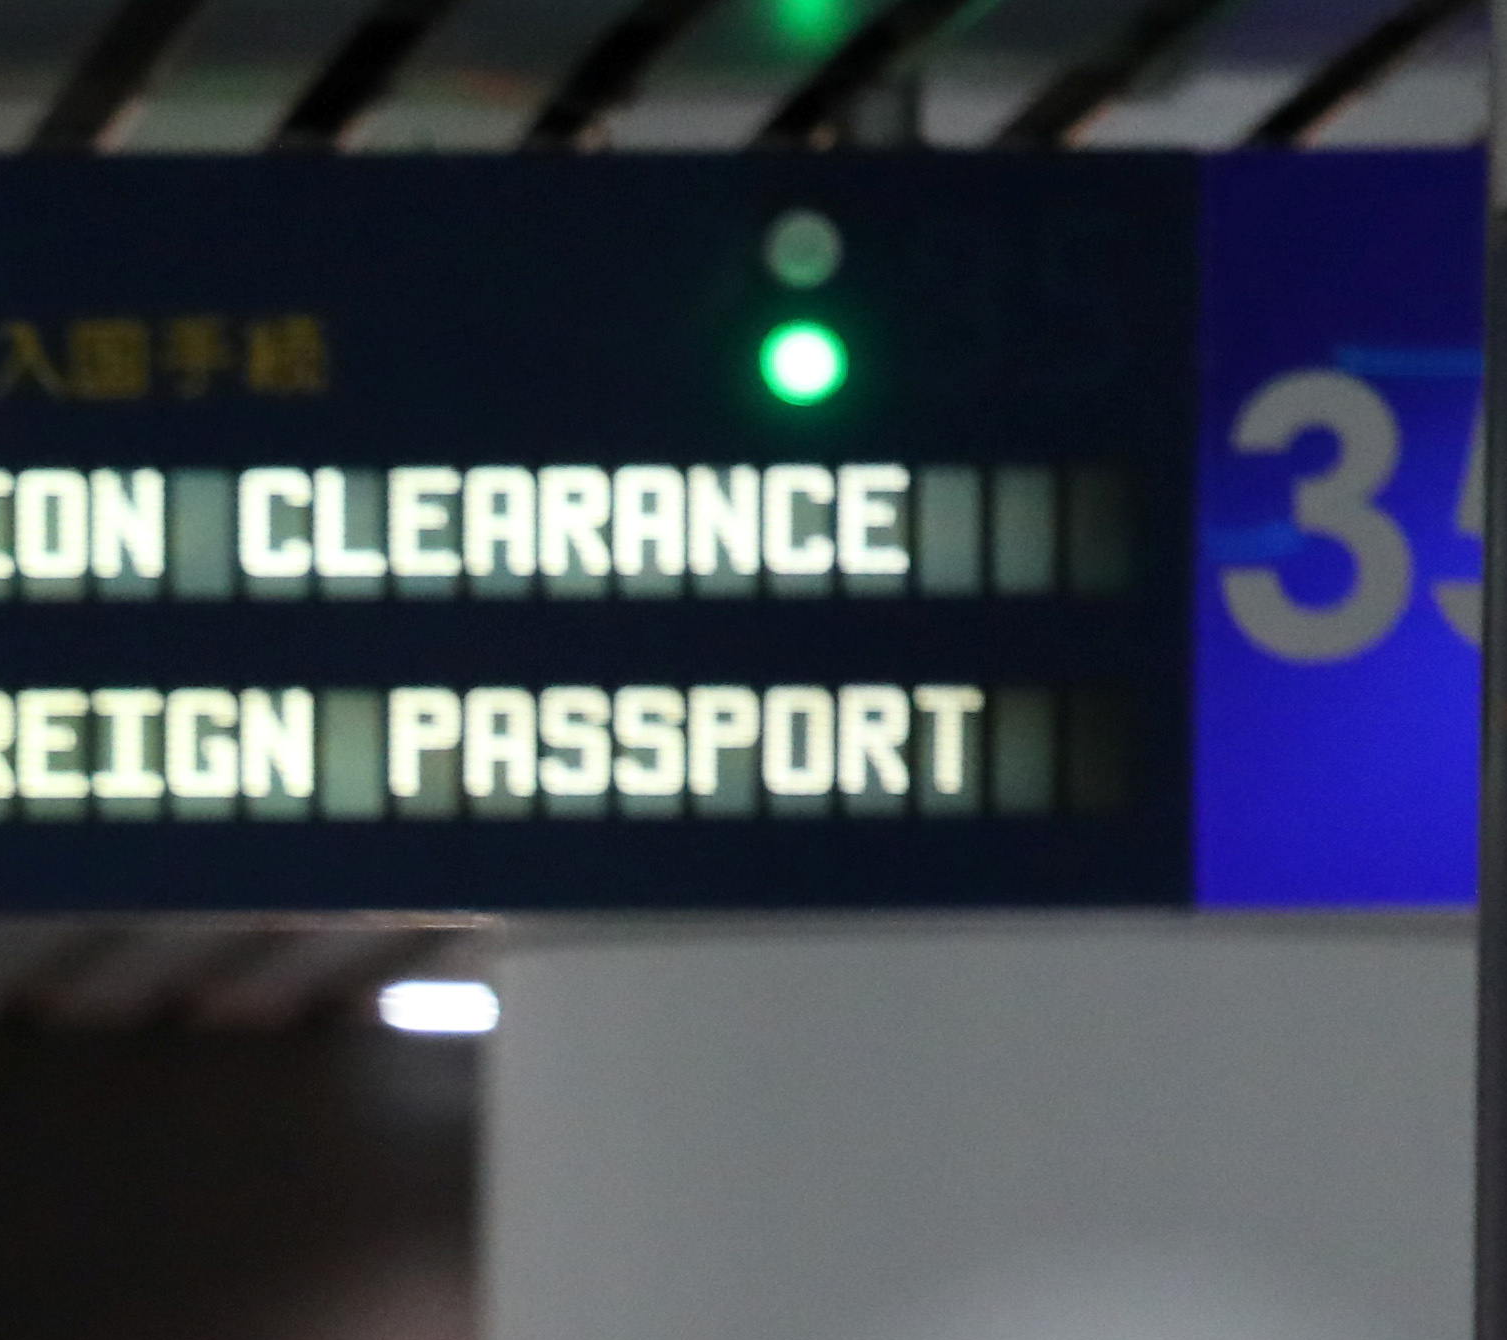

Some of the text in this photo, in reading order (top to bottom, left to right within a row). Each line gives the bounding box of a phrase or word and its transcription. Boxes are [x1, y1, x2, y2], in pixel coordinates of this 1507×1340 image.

[239, 464, 910, 580] CLEARANCE
[1220, 367, 1484, 664] 3
[387, 686, 984, 799] PASSPORT
